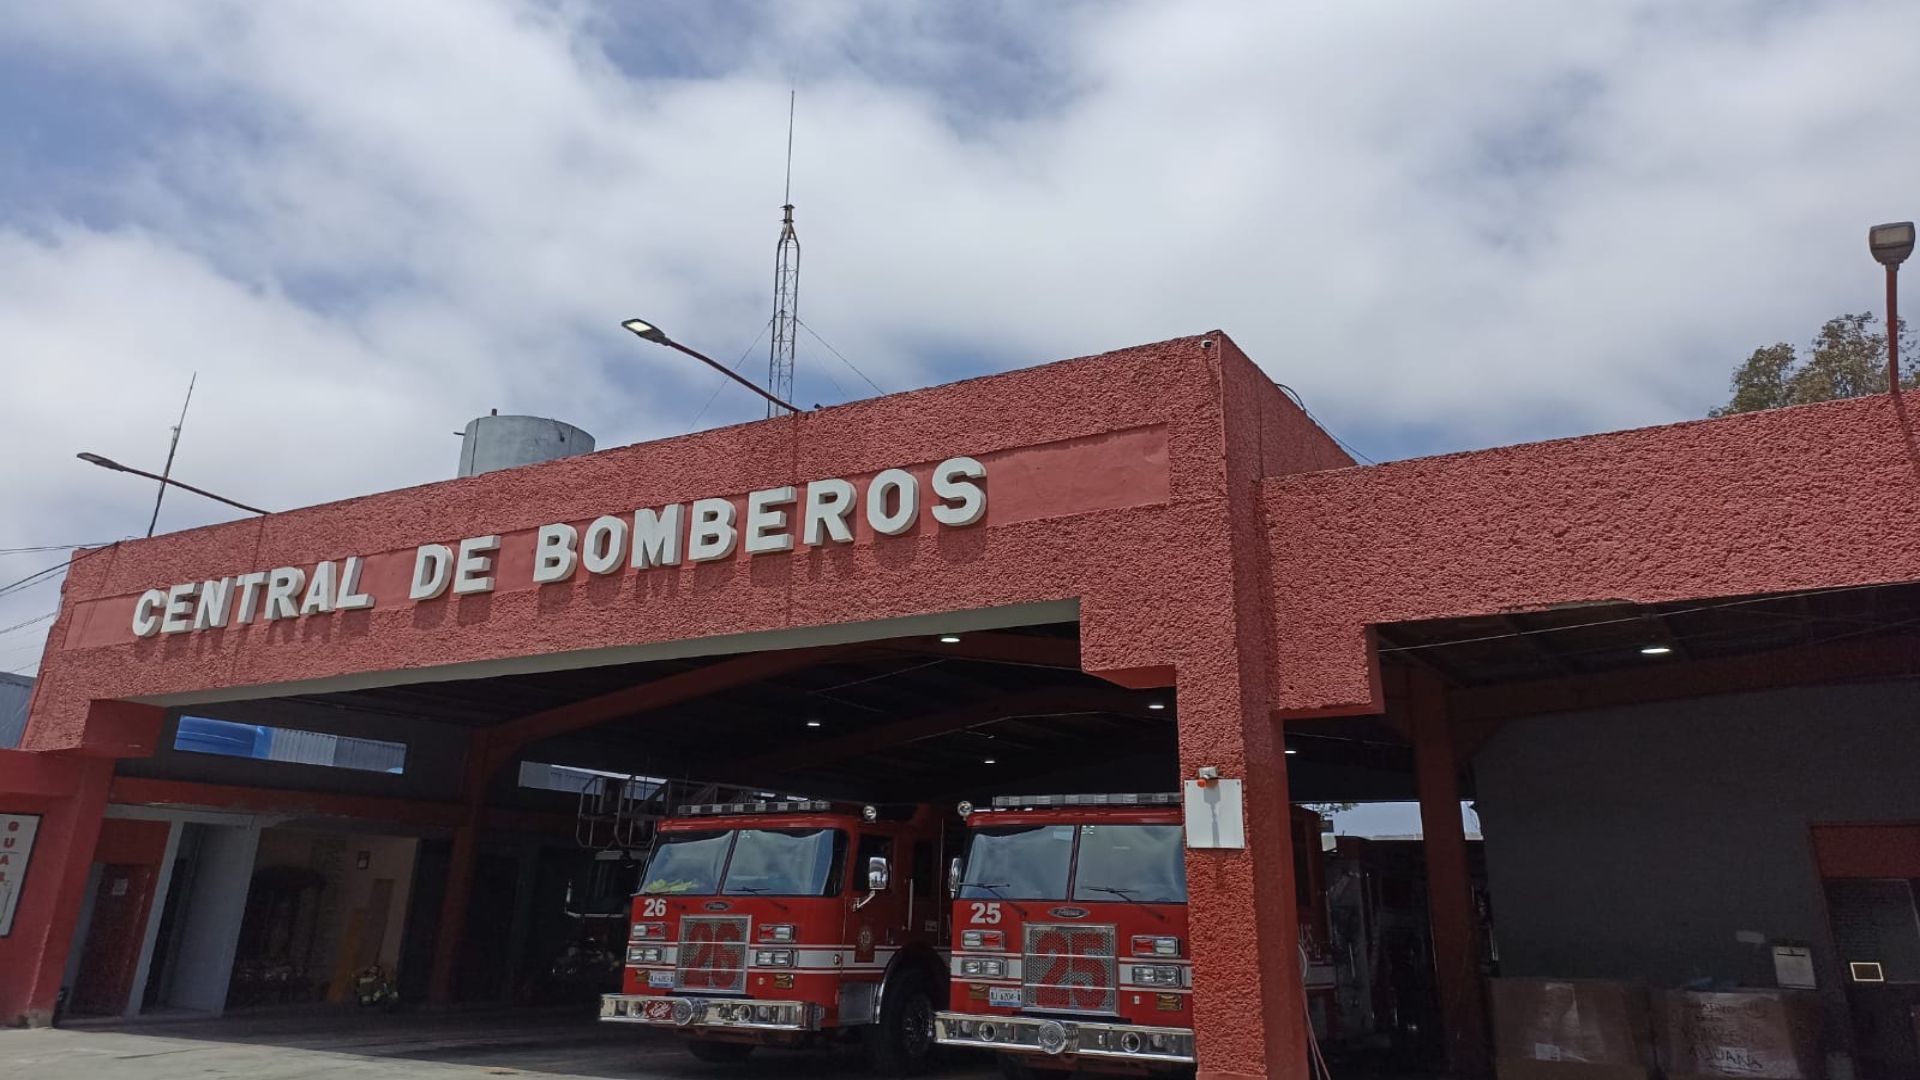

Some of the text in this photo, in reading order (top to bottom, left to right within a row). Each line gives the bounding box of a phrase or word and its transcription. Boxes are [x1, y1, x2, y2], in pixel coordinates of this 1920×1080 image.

[132, 456, 987, 637] CENTRAL DE BOMBEROS
[643, 898, 667, 917] 26
[970, 902, 1002, 924] 25
[684, 922, 740, 988] 26
[1036, 930, 1107, 1008] 25
